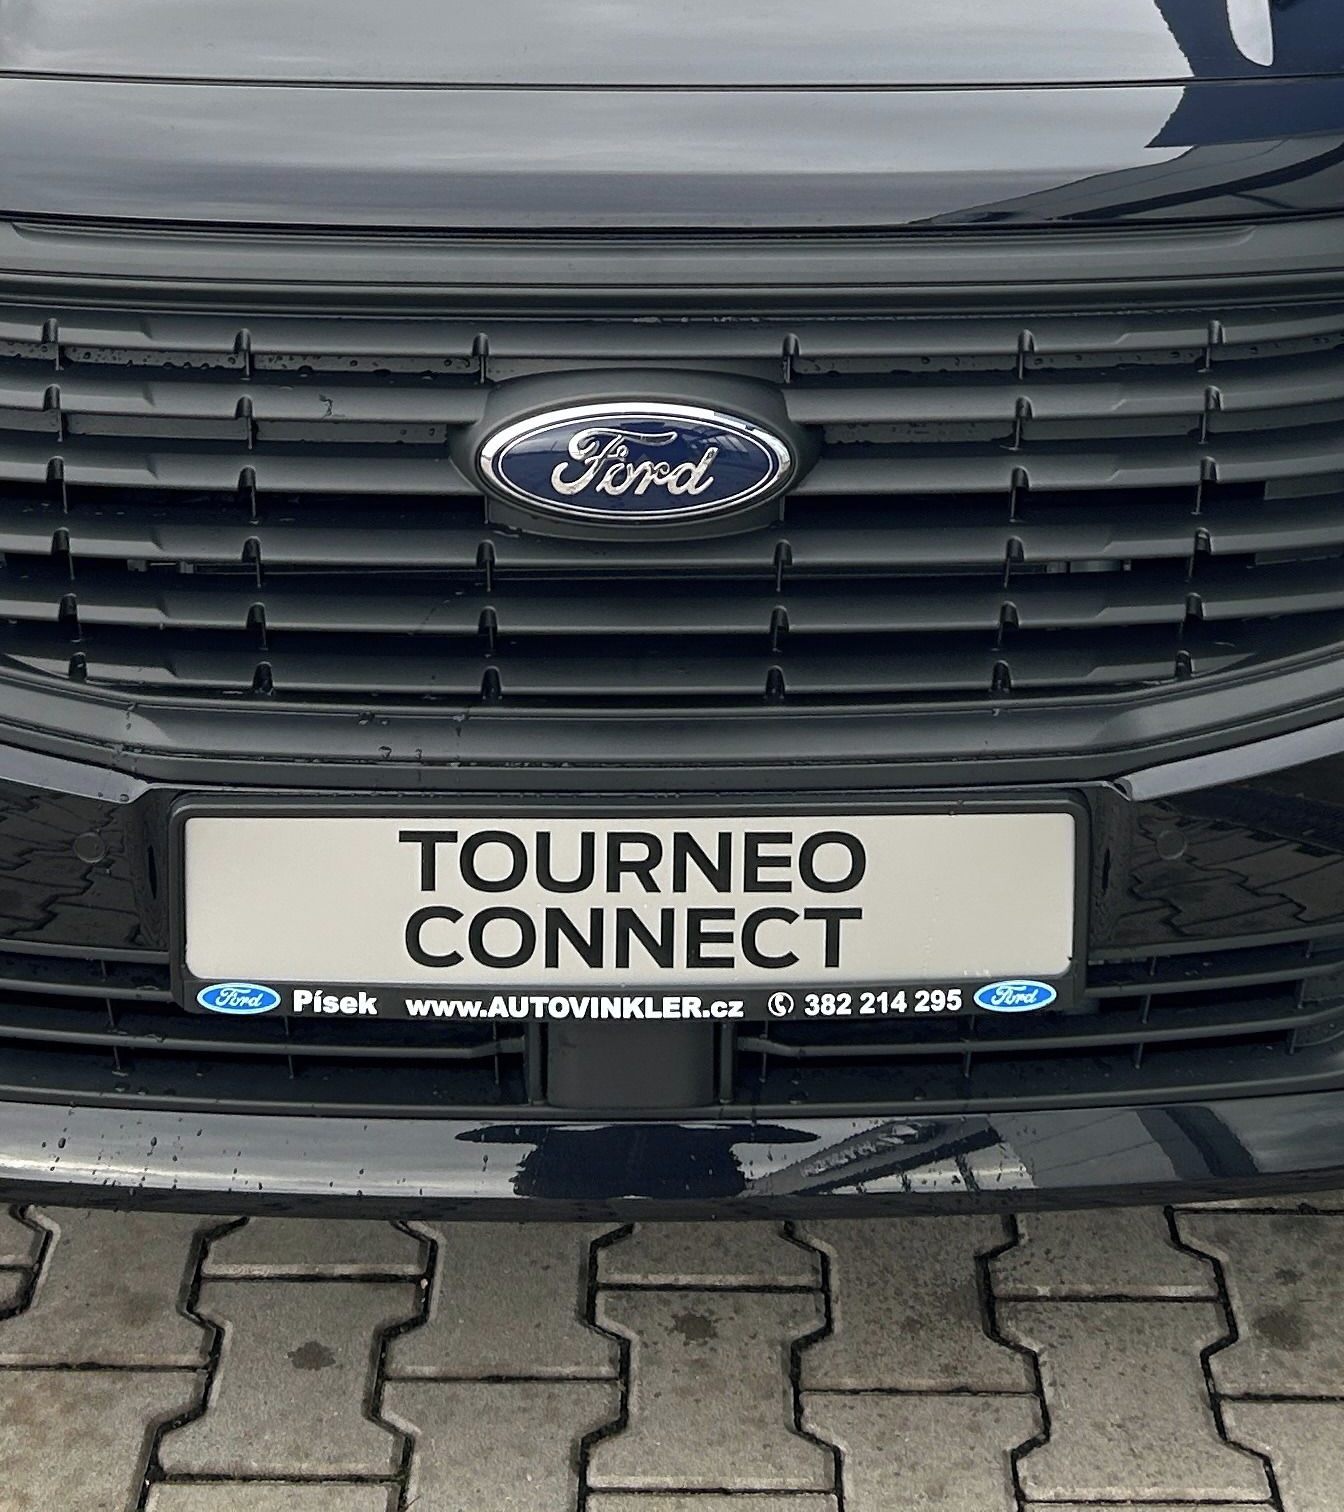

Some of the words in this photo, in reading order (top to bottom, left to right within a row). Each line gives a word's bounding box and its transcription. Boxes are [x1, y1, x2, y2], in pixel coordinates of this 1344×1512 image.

[551, 427, 719, 496] Ford
[398, 830, 867, 893] TOURNEO
[405, 905, 863, 969] CONNECT
[215, 988, 264, 1007] Ford
[293, 989, 378, 1016] Písek
[405, 995, 744, 1020] www.AUTOVINKLER.cz
[804, 994, 853, 1017] 382
[859, 991, 908, 1015] 214
[914, 989, 963, 1013] 295
[990, 985, 1039, 1006] Ford
